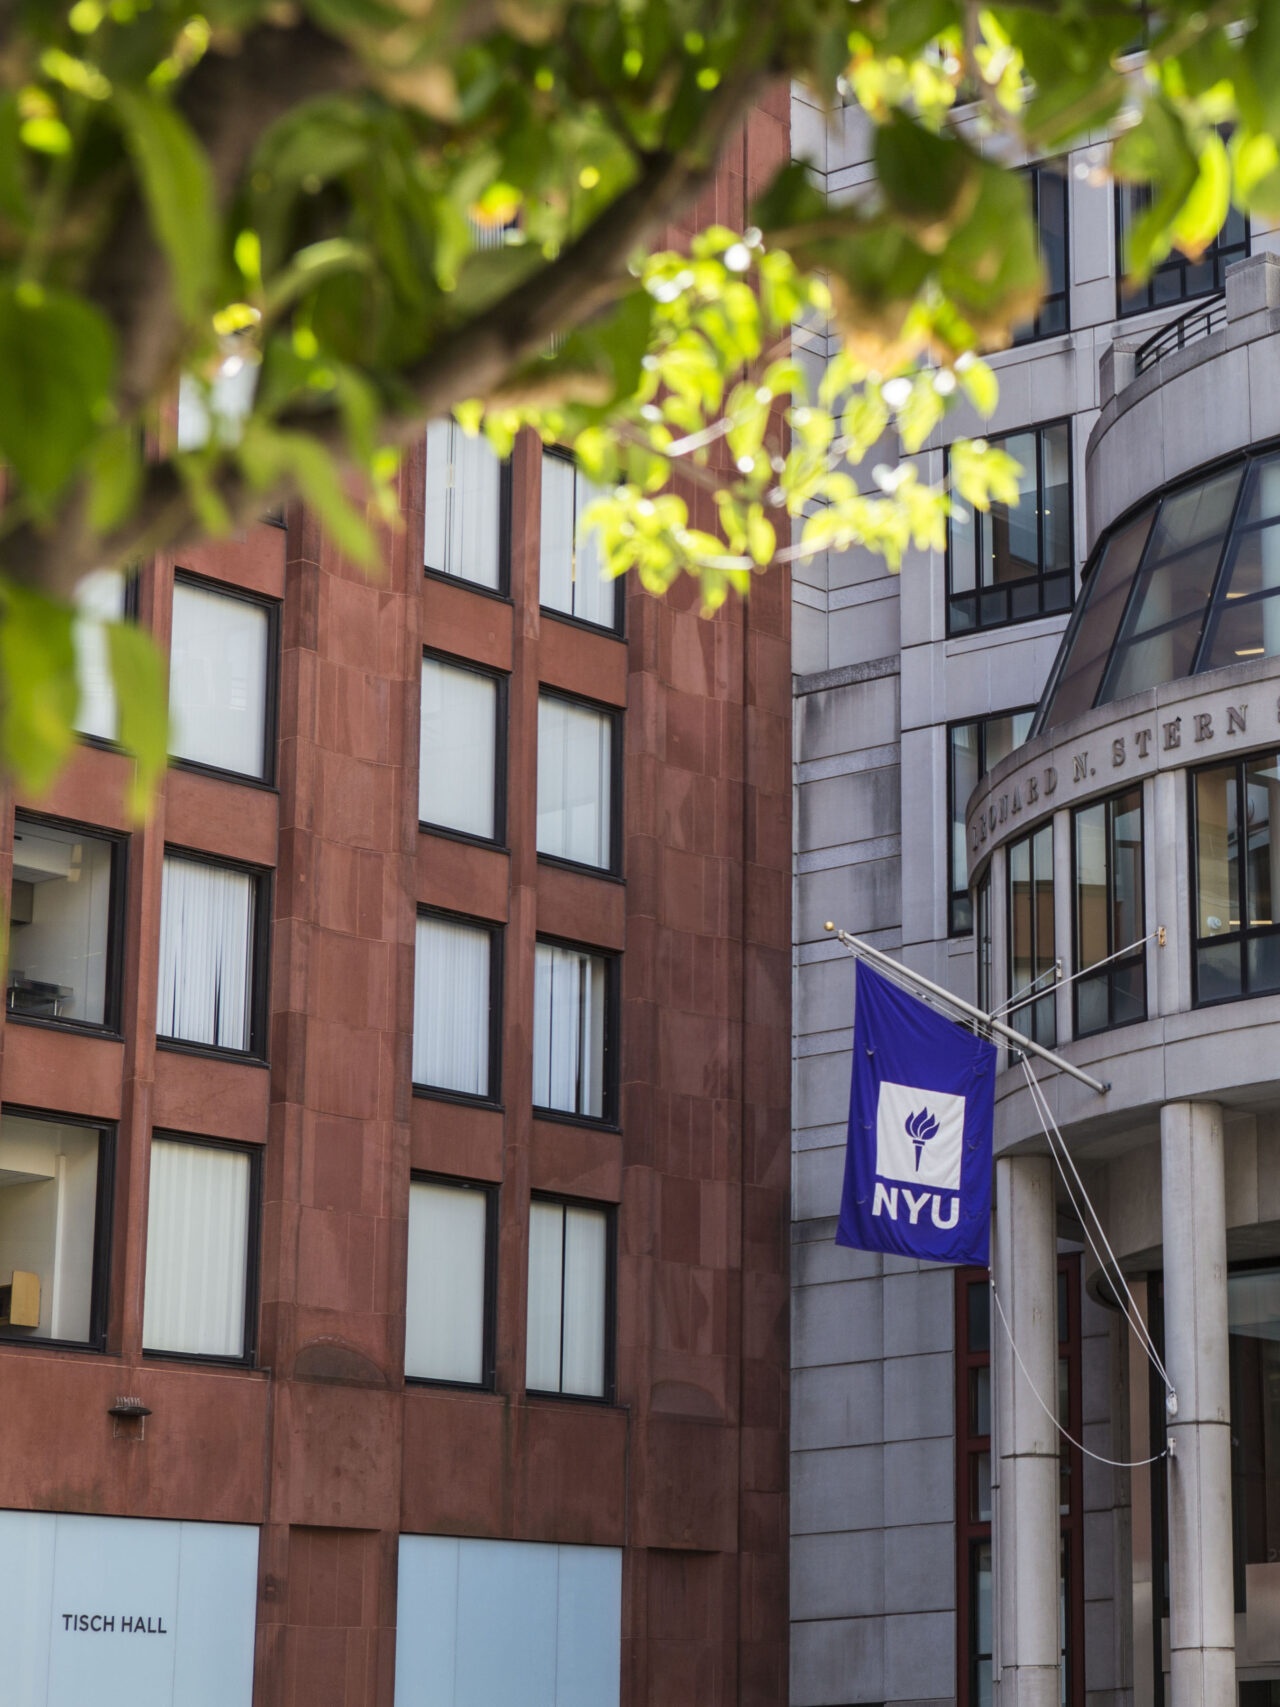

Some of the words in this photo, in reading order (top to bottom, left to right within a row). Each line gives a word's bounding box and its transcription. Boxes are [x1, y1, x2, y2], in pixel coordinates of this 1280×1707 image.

[971, 767, 1058, 852] LEONARD
[1072, 752, 1097, 783] N.
[1112, 703, 1249, 768] STERN
[871, 1182, 960, 1230] NYU
[61, 1613, 116, 1633] TISCH
[120, 1615, 168, 1634] HALL
